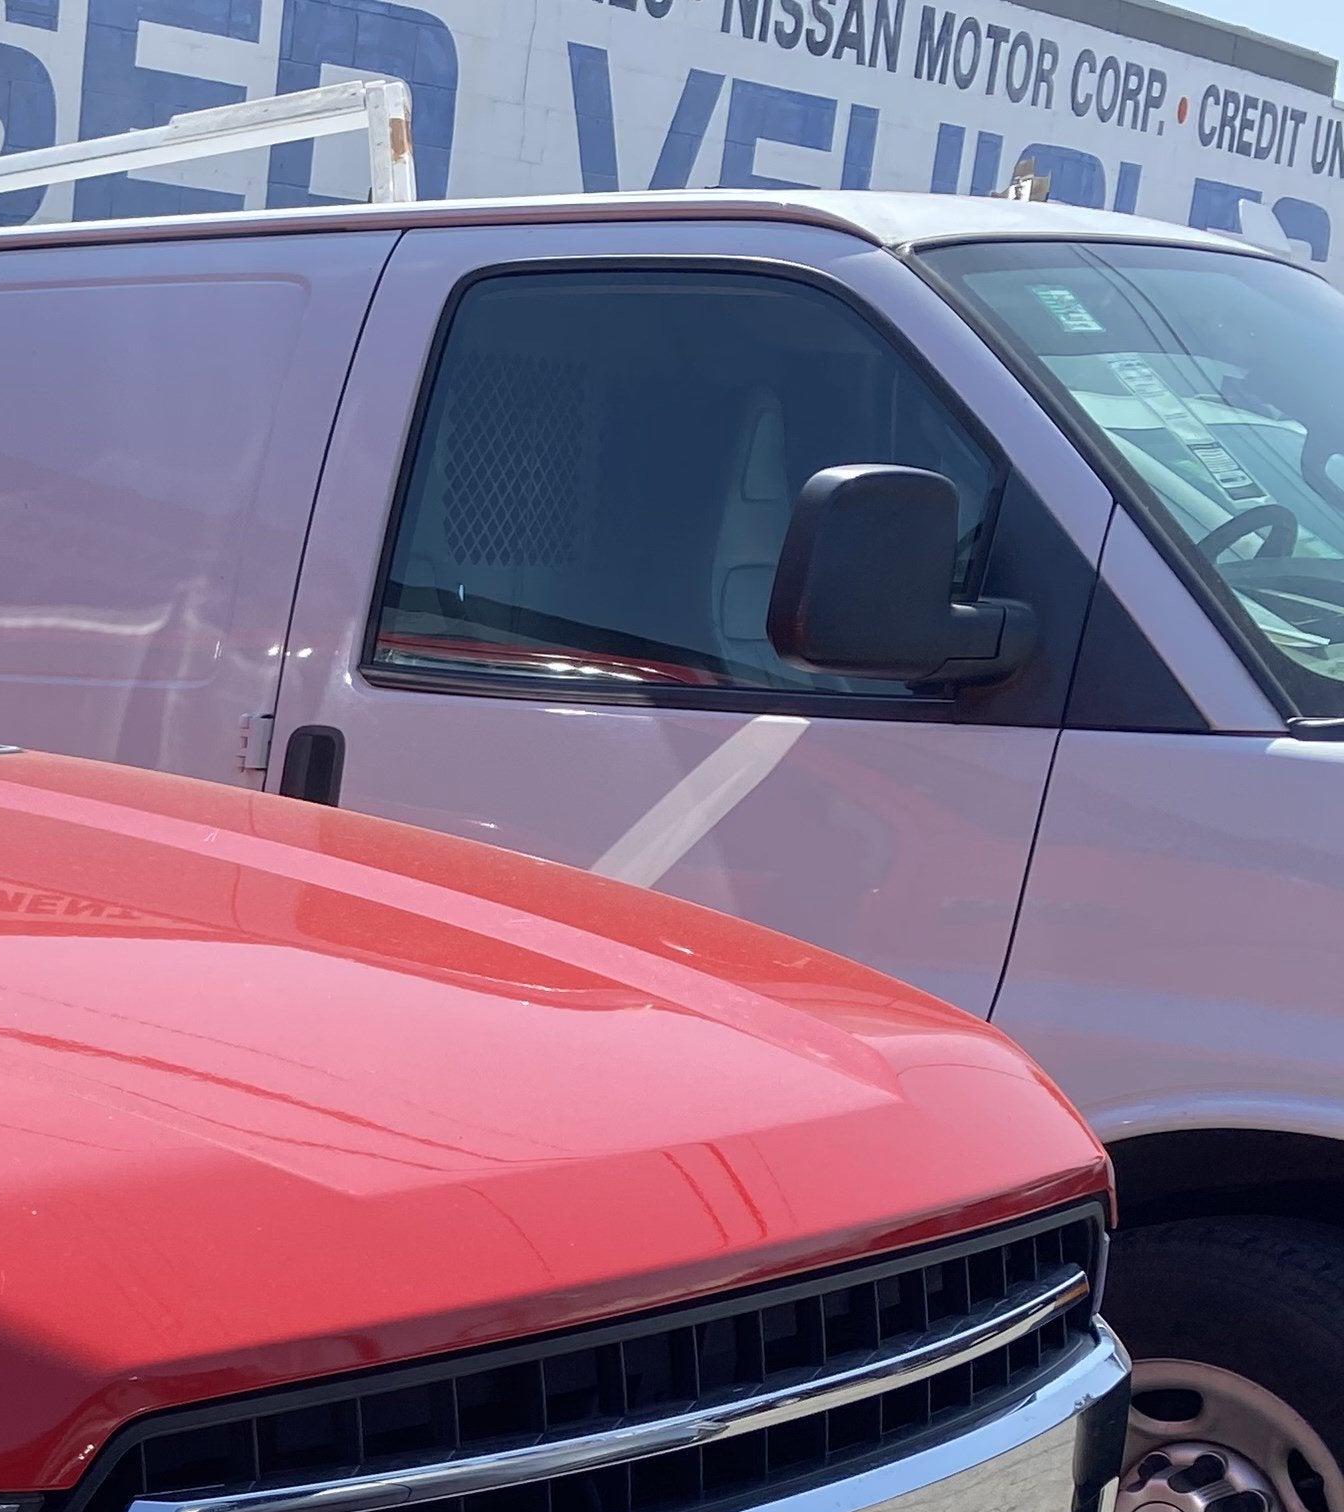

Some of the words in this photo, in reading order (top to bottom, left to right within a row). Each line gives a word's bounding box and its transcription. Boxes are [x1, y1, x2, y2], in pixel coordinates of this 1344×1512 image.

[721, 0, 906, 73] NISSAN
[914, 5, 1059, 110] MOTOR
[1070, 49, 1167, 136] CORP.
[1198, 84, 1308, 168] CREDIT
